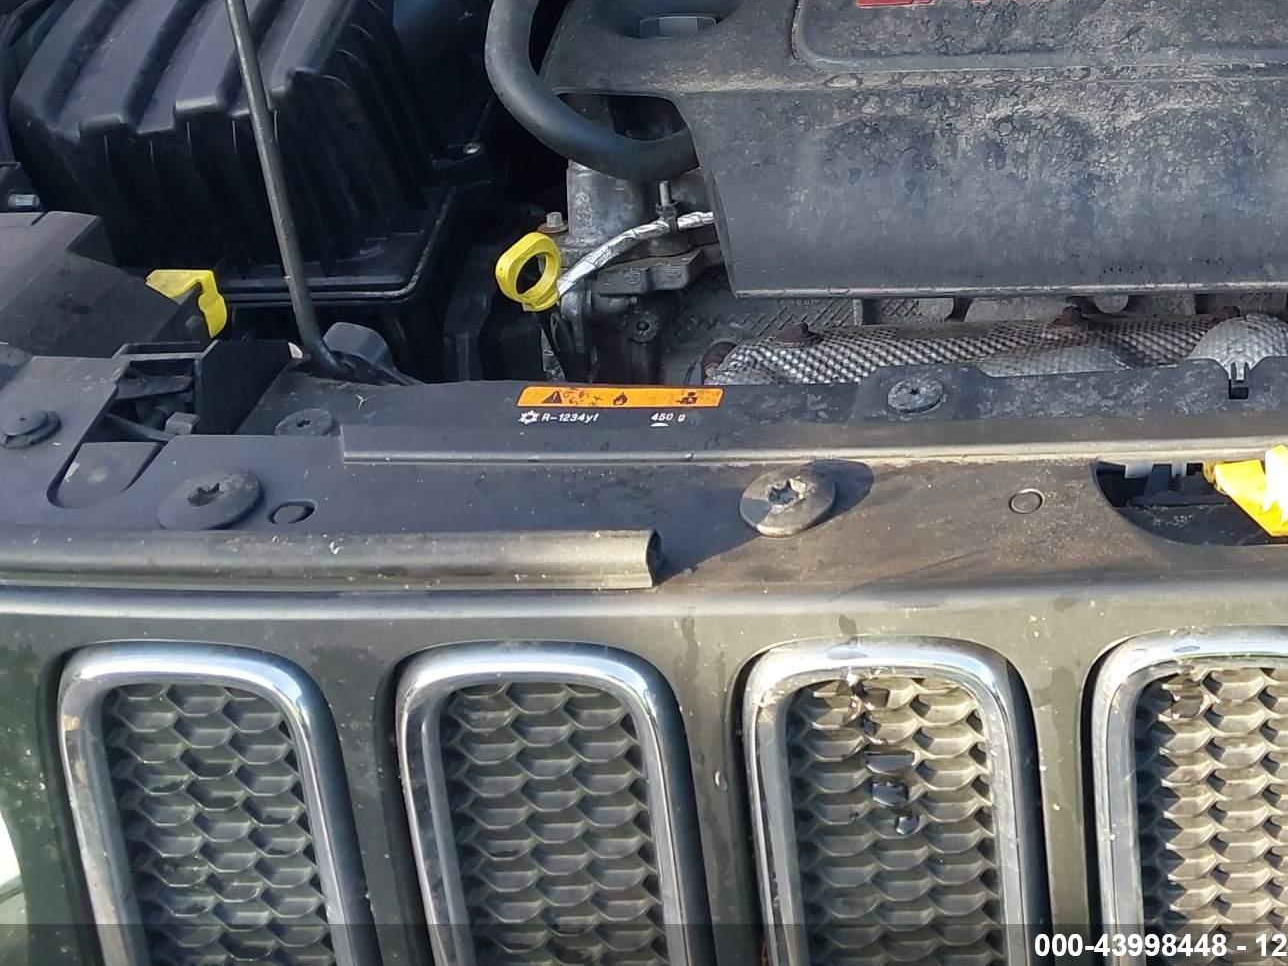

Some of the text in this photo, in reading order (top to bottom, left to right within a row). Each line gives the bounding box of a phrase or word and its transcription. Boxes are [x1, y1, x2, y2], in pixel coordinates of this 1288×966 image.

[541, 412, 687, 424] R-1234yf 450 g
